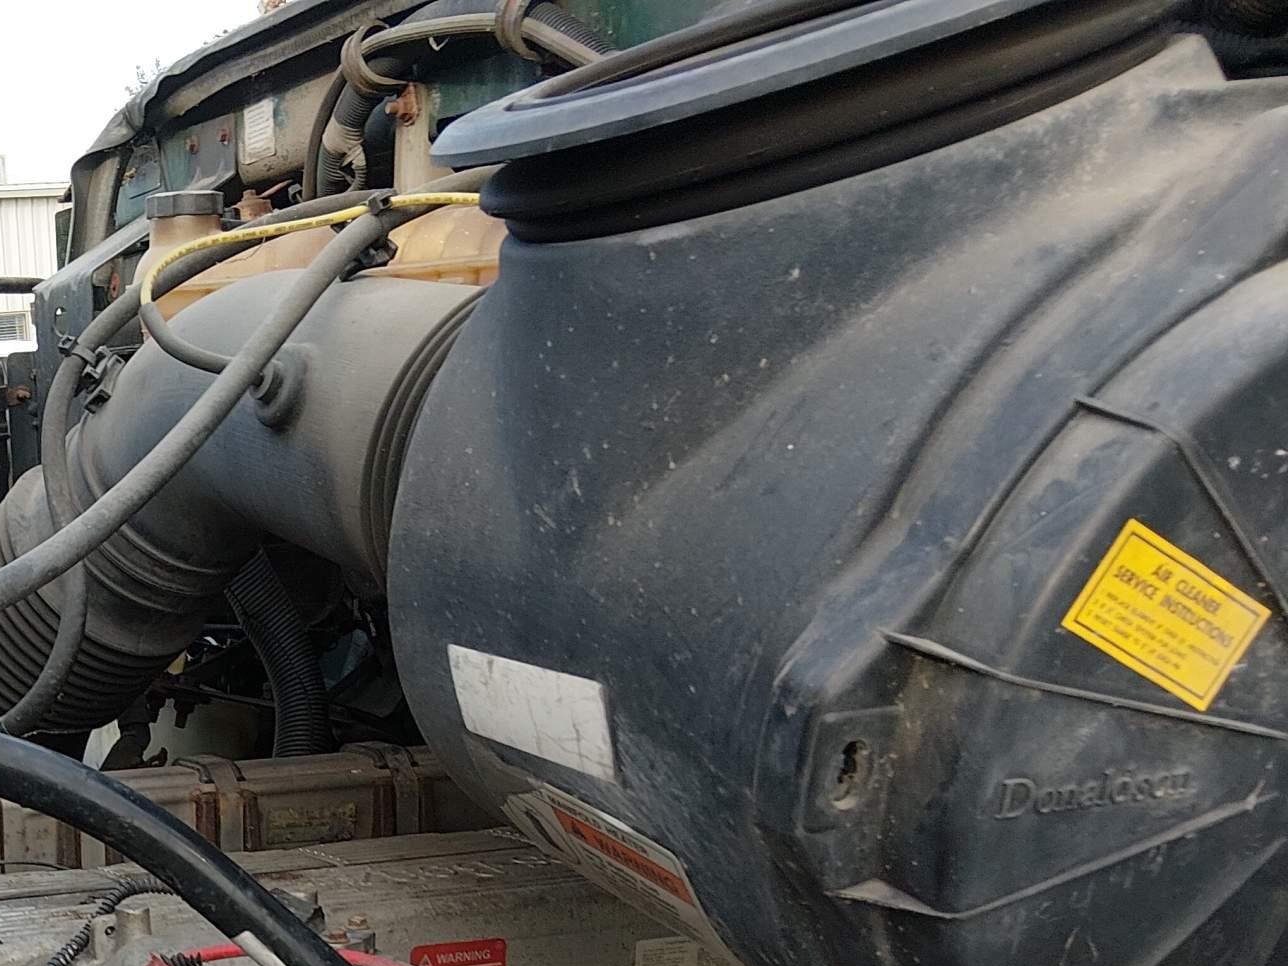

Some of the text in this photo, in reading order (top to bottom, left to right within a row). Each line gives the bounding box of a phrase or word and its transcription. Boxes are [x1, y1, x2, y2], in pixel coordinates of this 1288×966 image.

[1151, 563, 1175, 583] AIR
[1114, 565, 1161, 601] SERVICE
[1160, 595, 1235, 648] INSTRUCTIONS
[993, 764, 1200, 820] Donaldson
[436, 949, 491, 965] WARNING
